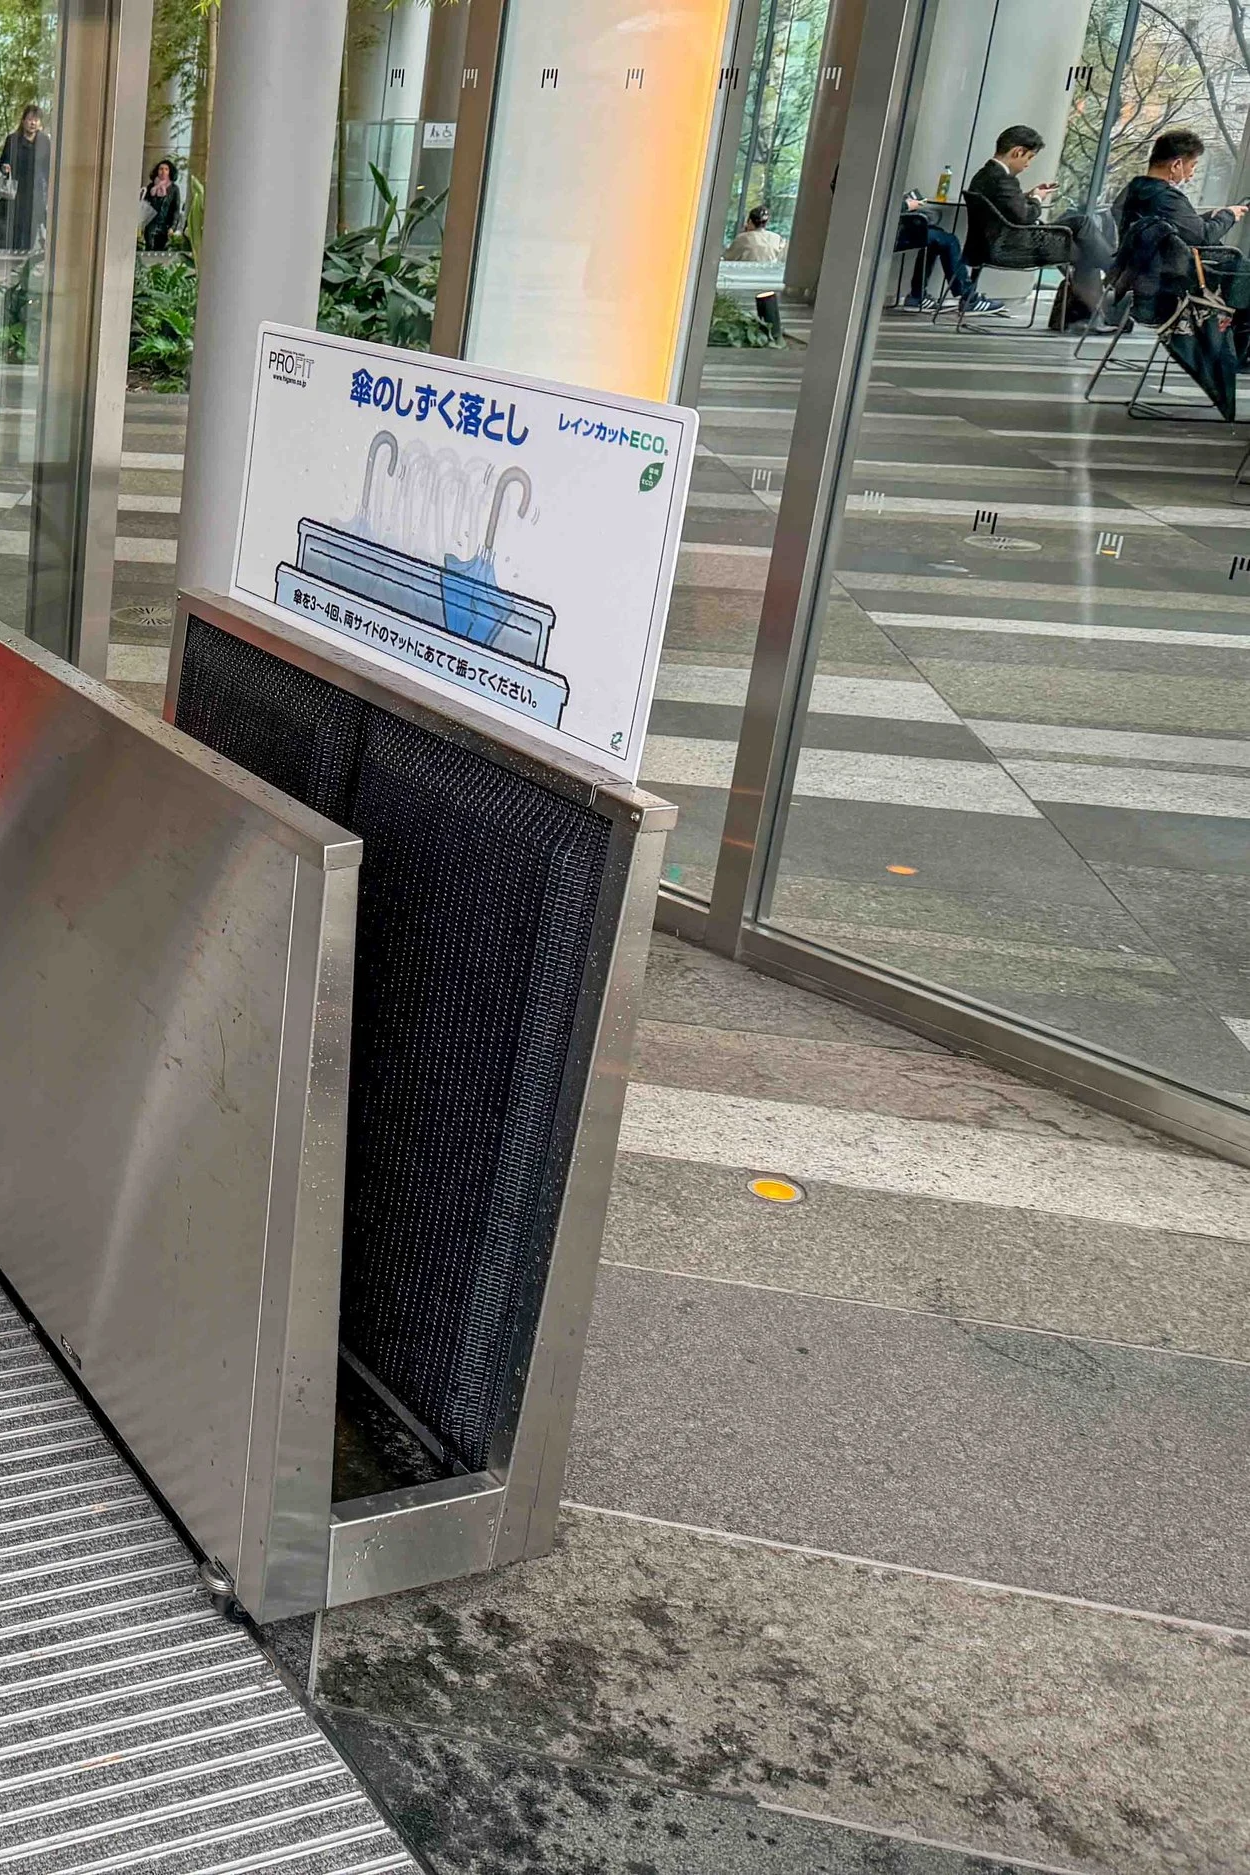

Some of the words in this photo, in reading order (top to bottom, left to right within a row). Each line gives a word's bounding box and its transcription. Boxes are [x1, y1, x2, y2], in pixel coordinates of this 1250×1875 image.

[269, 351, 315, 379] PROFIT
[350, 368, 529, 446] 傘のしずく落とし
